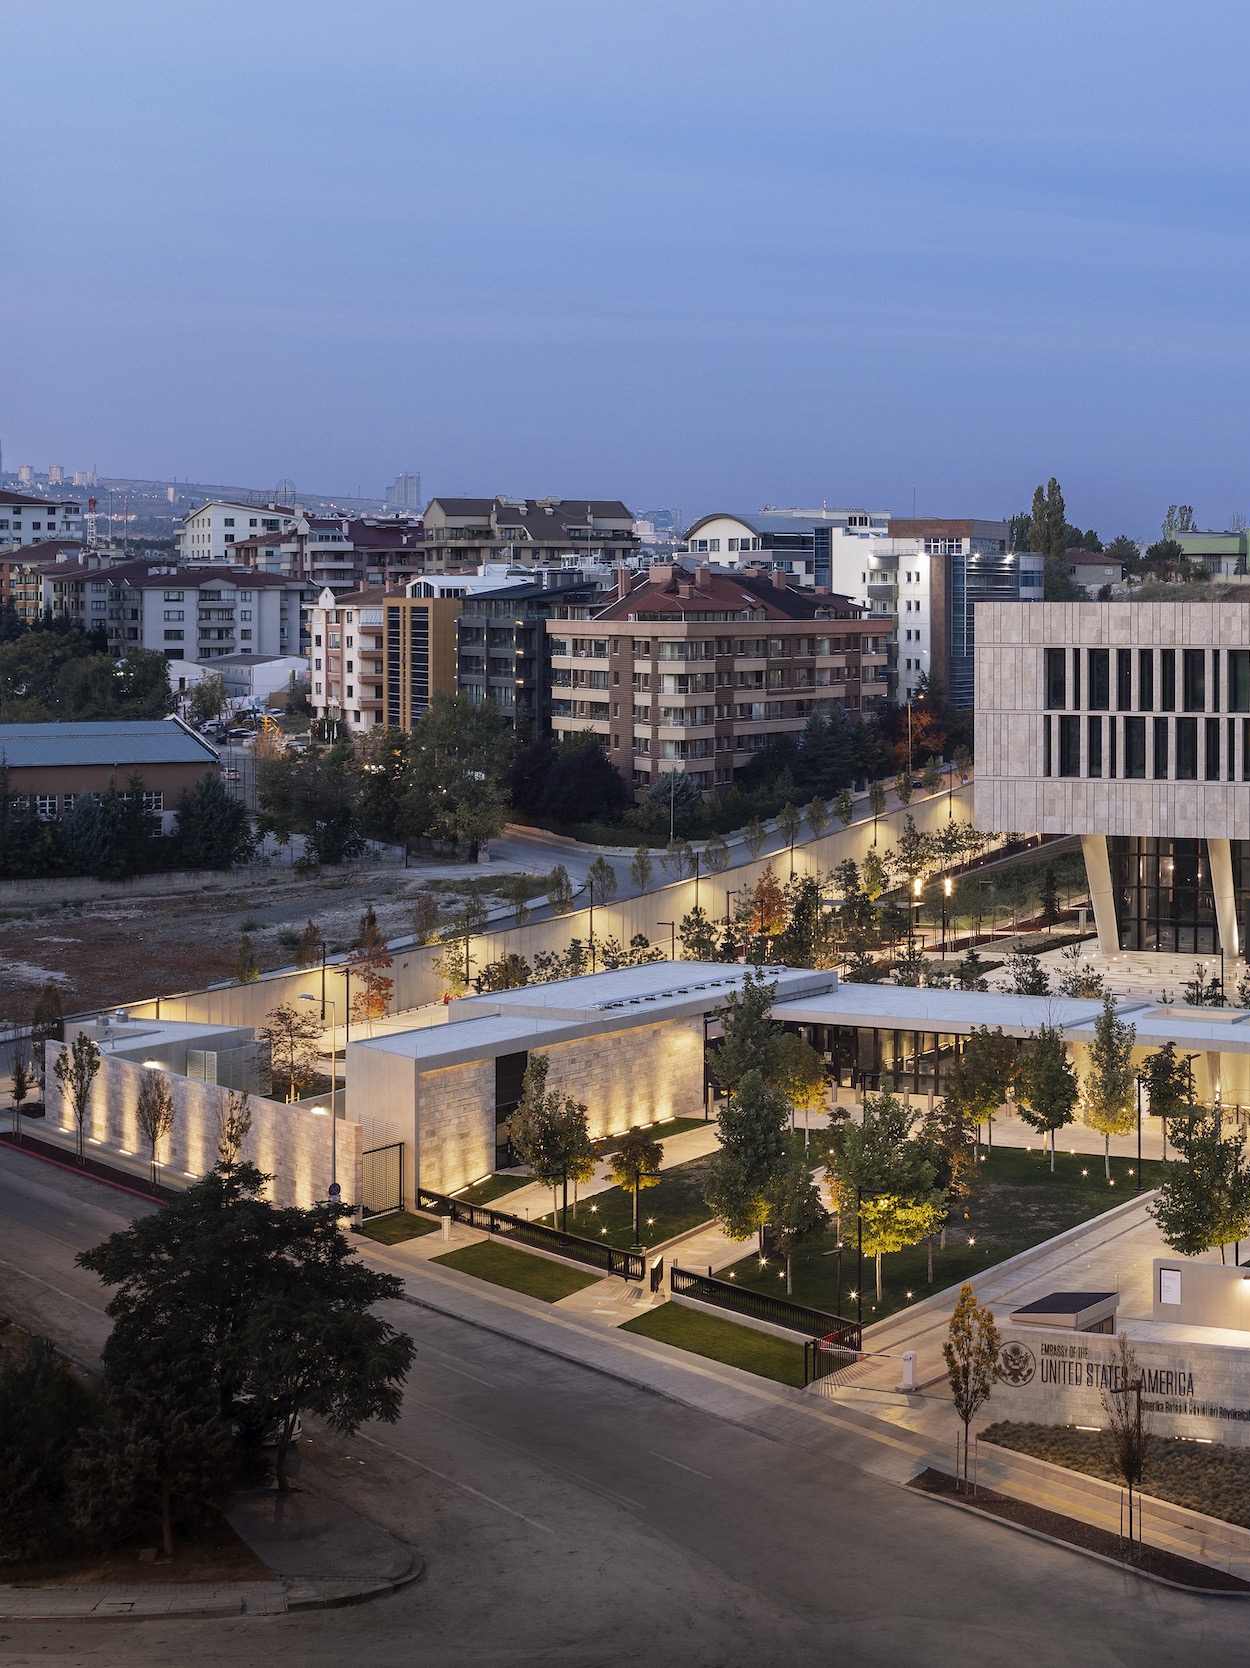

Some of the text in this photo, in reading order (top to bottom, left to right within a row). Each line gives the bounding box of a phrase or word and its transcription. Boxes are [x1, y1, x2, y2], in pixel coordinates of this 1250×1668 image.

[1041, 1343, 1089, 1360] EMBASSY OF THE
[1041, 1359, 1195, 1398] UNITED STATES AMERICA
